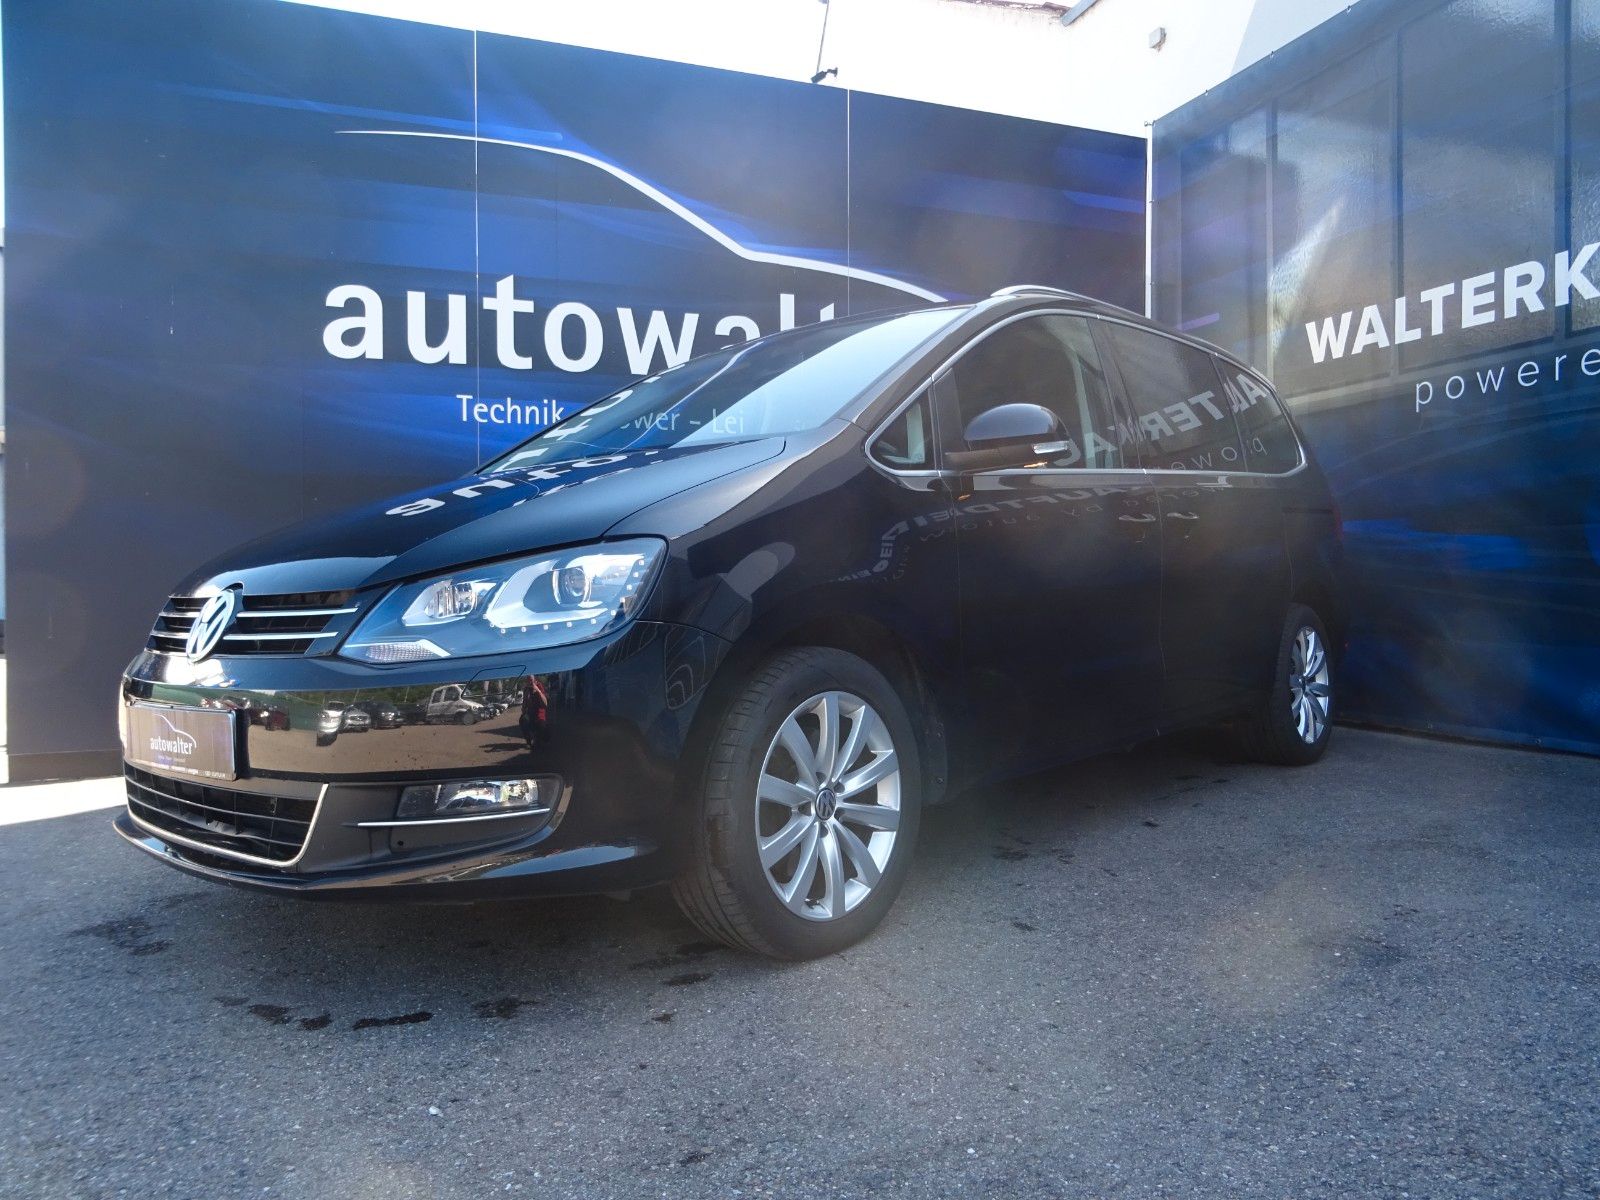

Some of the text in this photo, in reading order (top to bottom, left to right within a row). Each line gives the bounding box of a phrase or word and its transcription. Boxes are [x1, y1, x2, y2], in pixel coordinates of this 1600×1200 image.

[322, 274, 835, 375] autow
[1305, 242, 1600, 364] WALTERK
[456, 394, 565, 425] Technik
[1415, 348, 1600, 413] powere
[150, 736, 193, 755] autowalter
